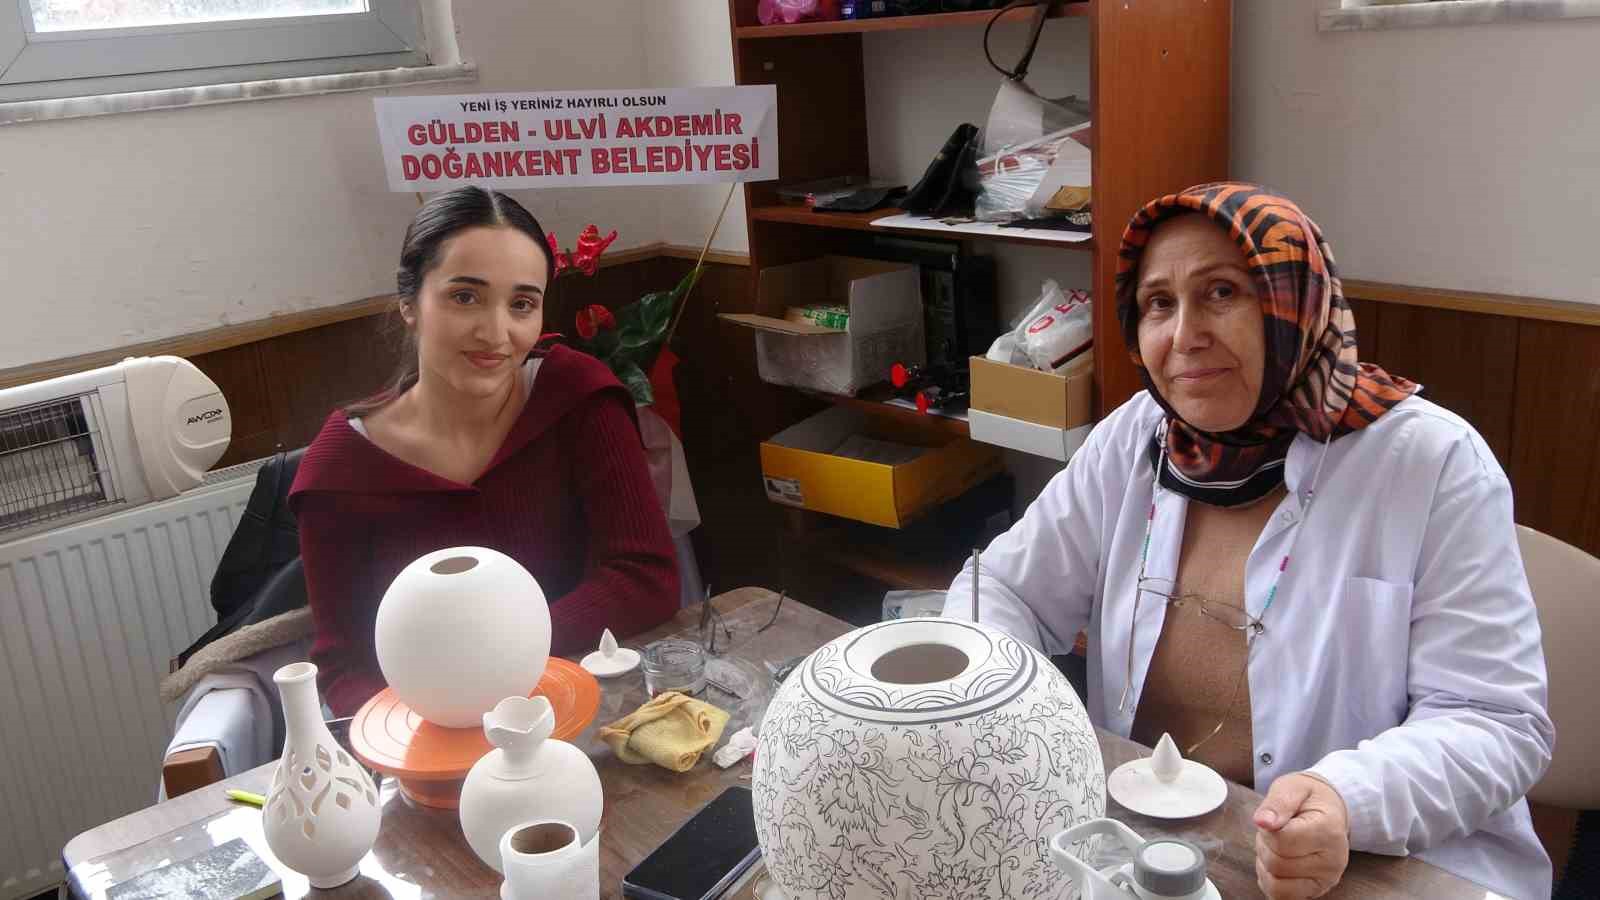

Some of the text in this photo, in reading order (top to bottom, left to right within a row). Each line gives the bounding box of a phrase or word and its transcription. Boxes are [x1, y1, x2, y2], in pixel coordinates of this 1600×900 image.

[460, 95, 666, 113] YENİ İŞ YERİNİZ HAYIRLI OLSUN
[407, 119, 520, 146] GÜLDEN
[543, 112, 607, 141] ULVİ
[615, 108, 743, 139] AKDEMİR
[401, 136, 760, 181] DOĞANKENT BELEDİYESİ
